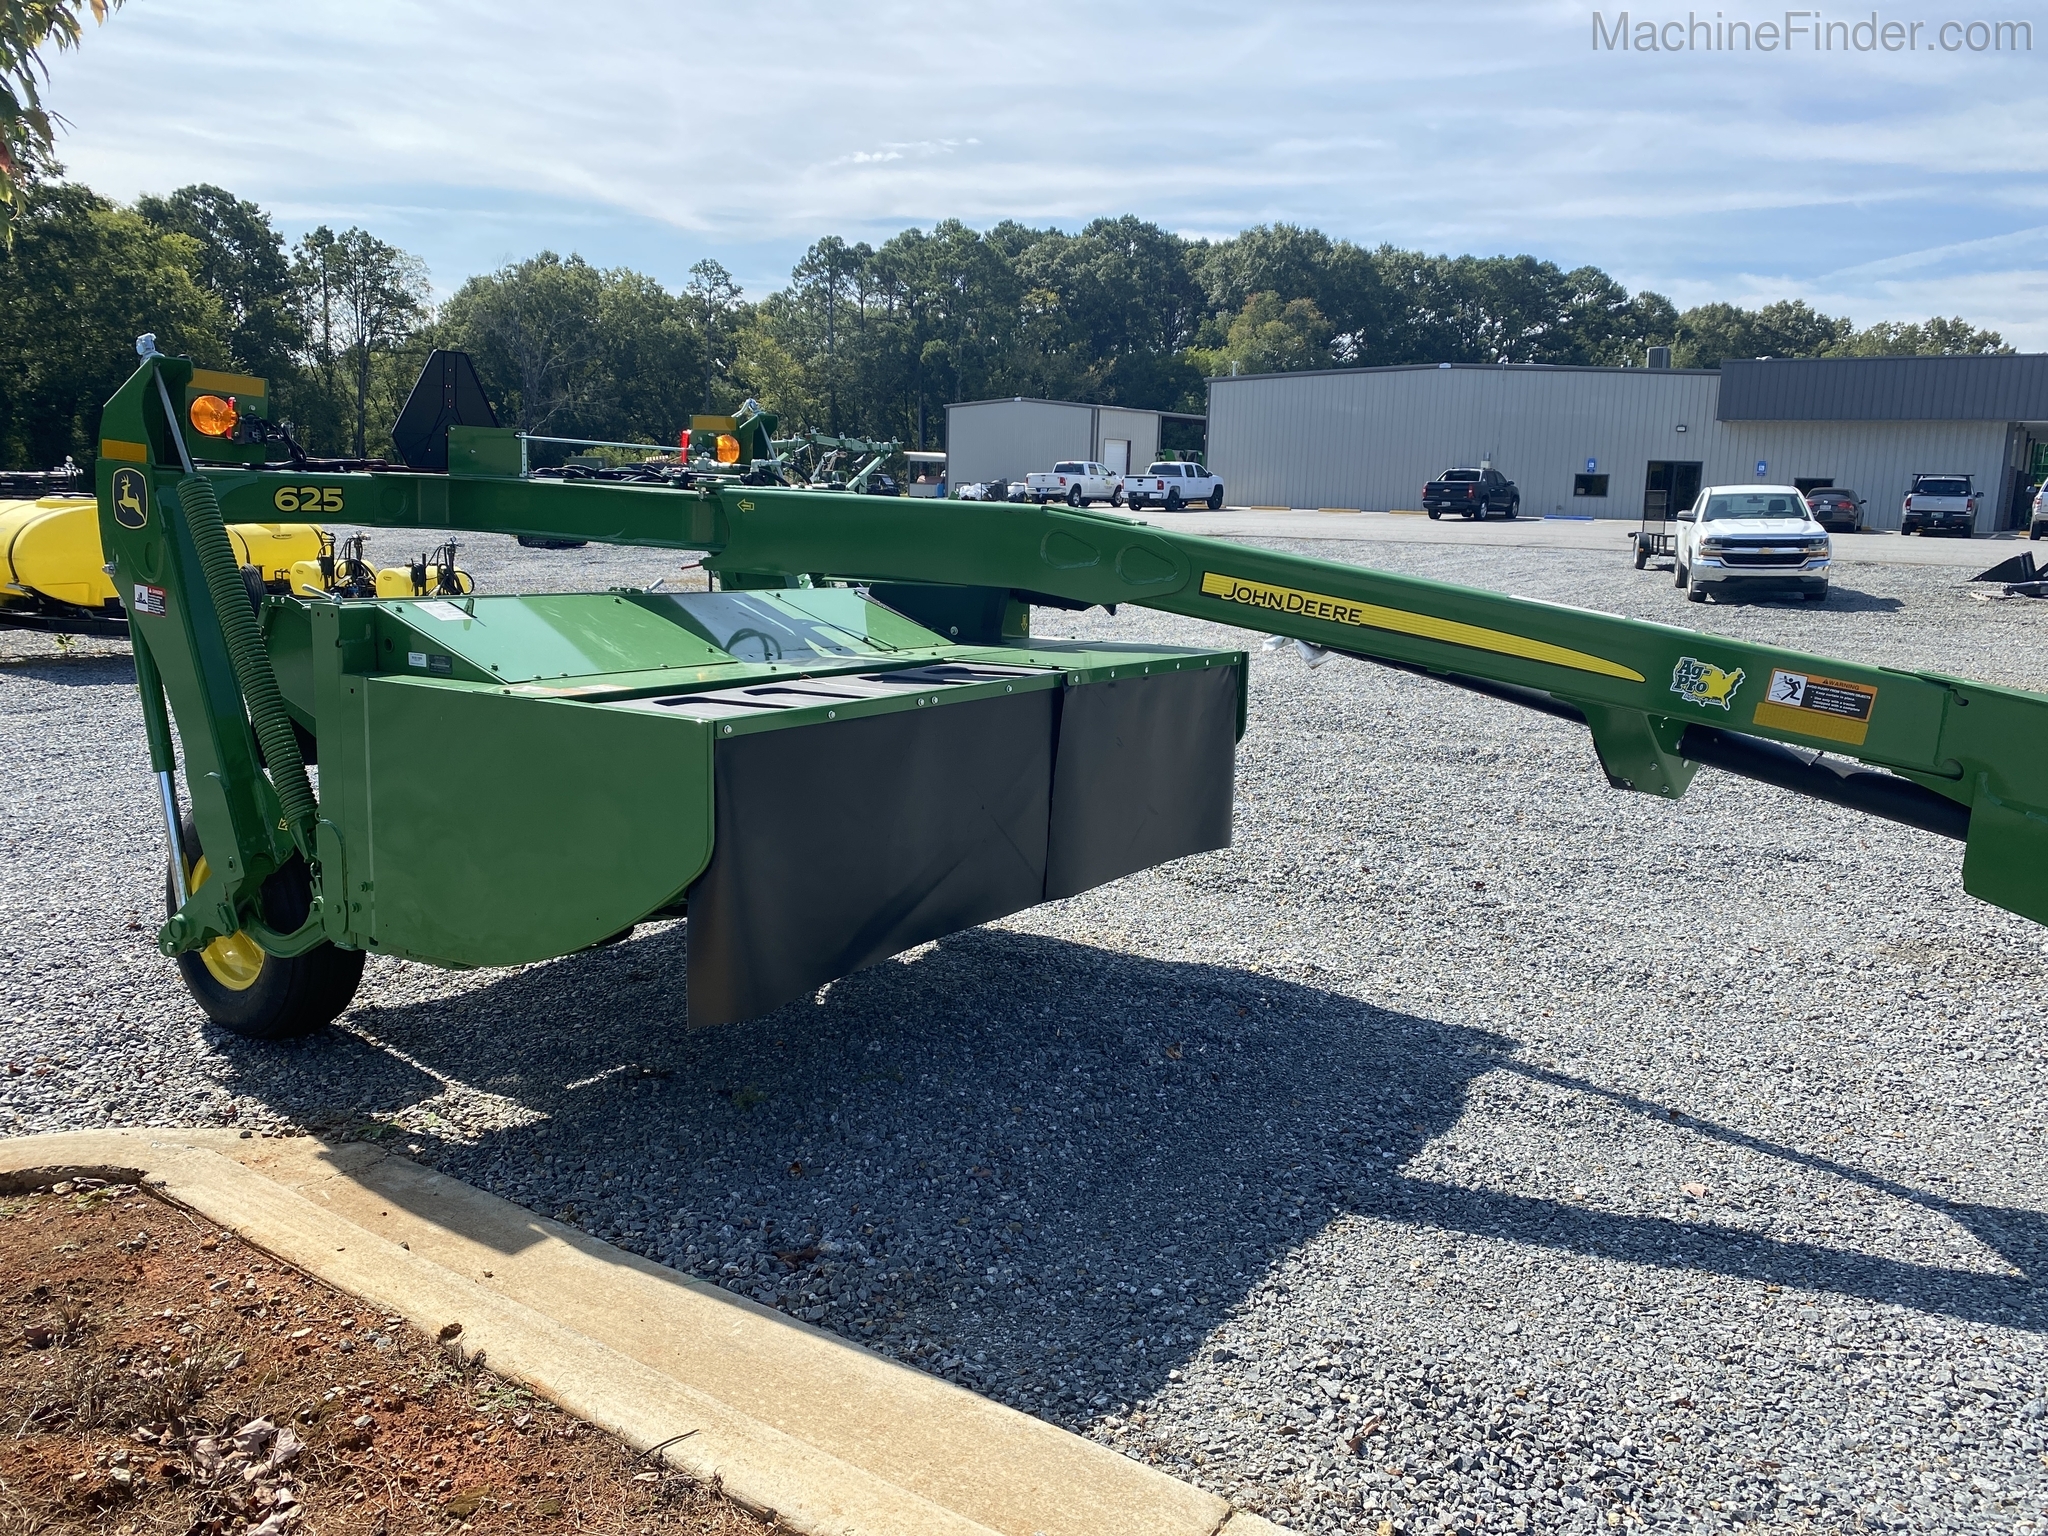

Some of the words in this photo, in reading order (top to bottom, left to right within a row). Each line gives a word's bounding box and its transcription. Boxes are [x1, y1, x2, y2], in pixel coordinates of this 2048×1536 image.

[274, 486, 344, 512] 625
[1222, 582, 1284, 609] JOHN
[1286, 592, 1363, 624] DEERE
[1677, 659, 1711, 680] Ag-
[1674, 675, 1708, 693] Pro
[1829, 680, 1860, 691] WARNING
